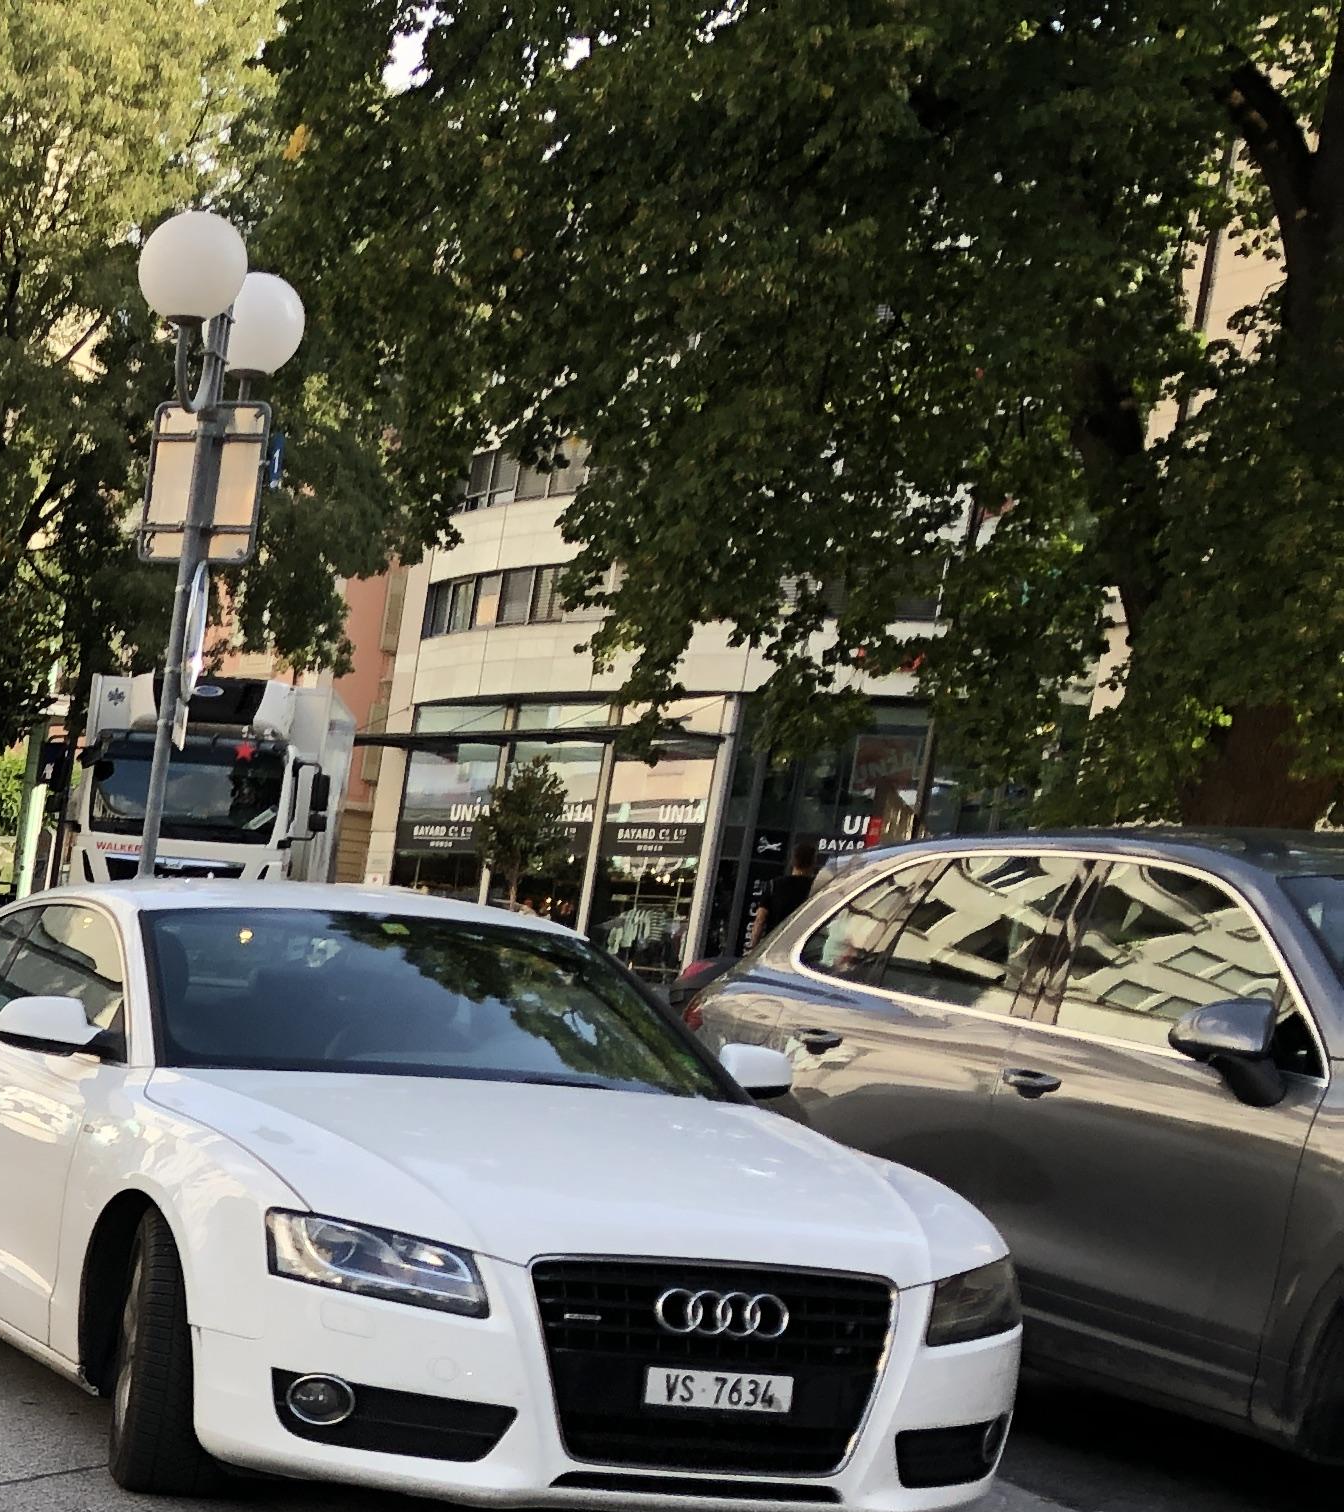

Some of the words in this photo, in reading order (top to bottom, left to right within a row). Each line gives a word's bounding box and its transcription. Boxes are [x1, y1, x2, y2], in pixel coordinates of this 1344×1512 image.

[413, 824, 447, 836] BAYARD
[617, 828, 656, 840] BAYARD
[818, 838, 865, 850] BAYAR
[714, 1376, 776, 1408] 7634
